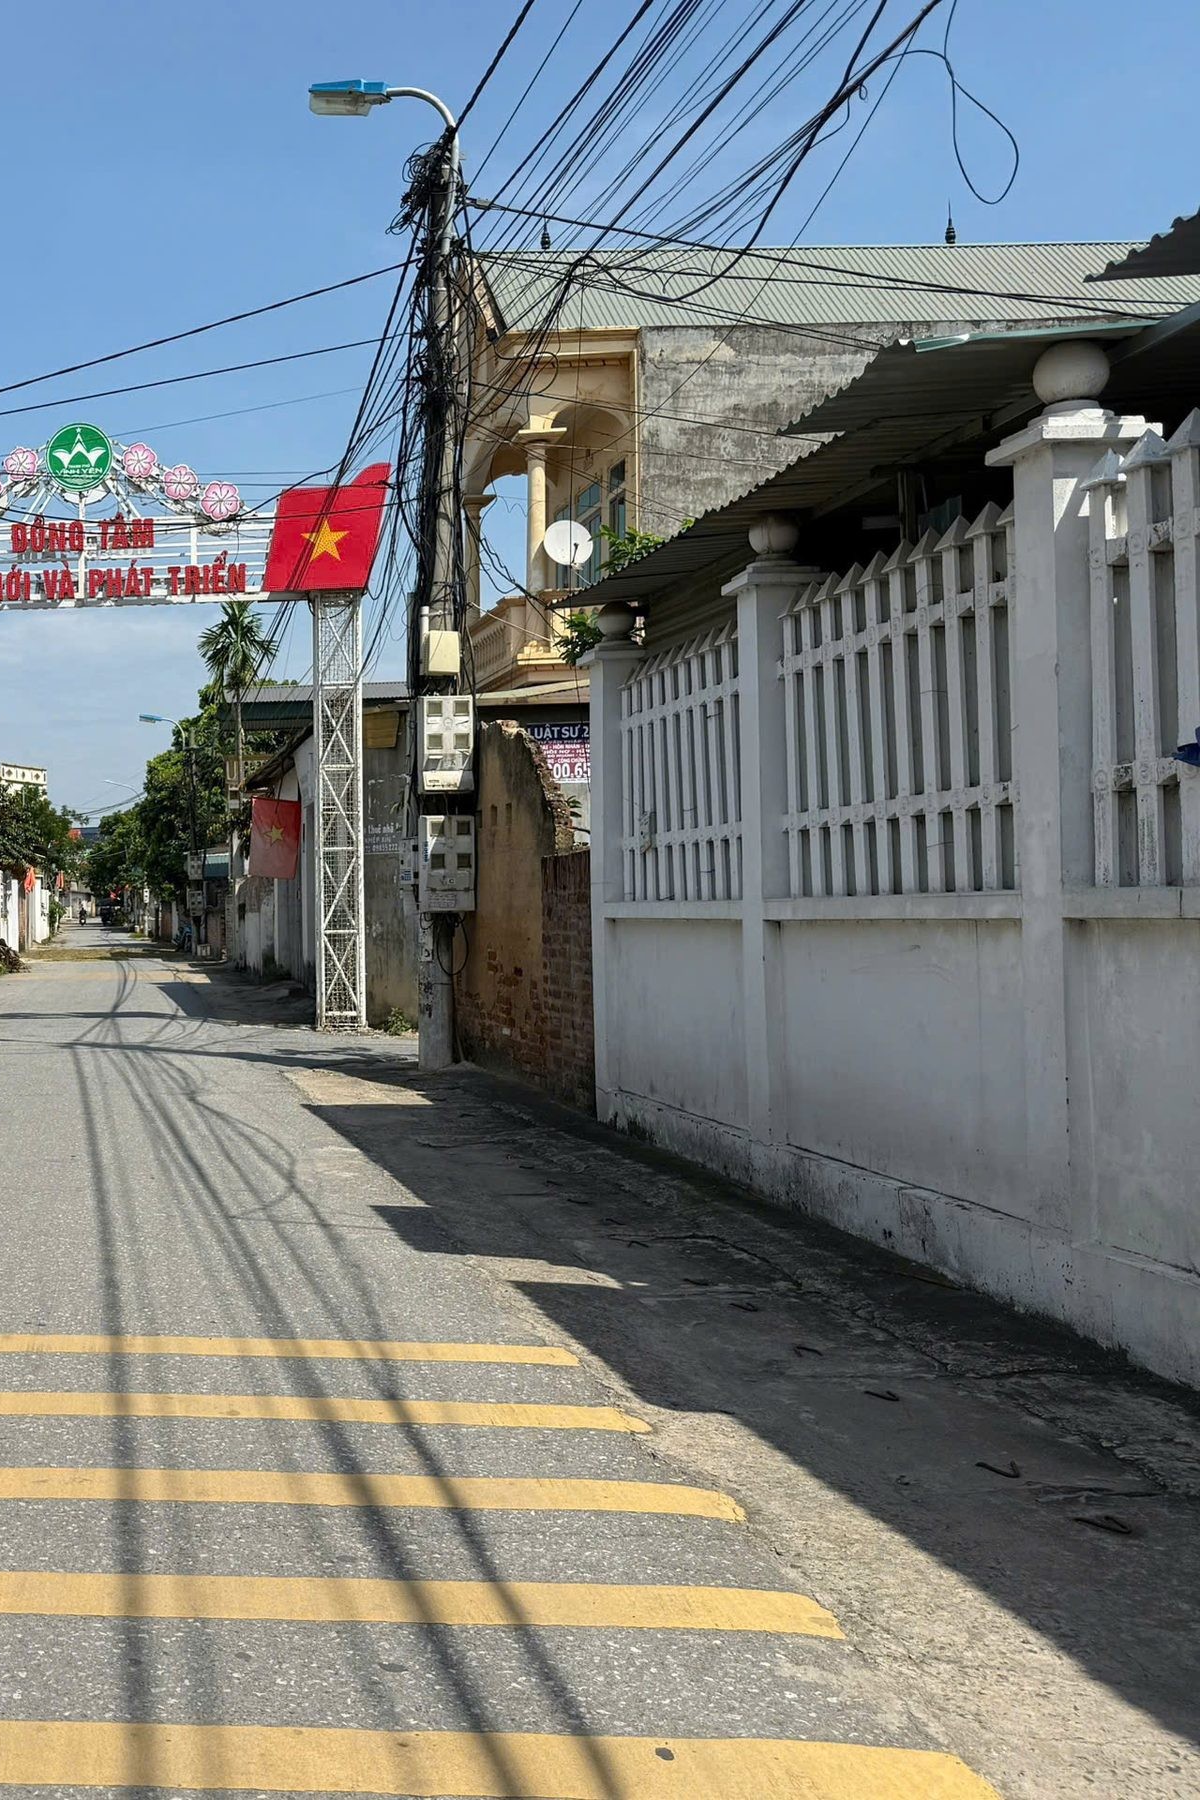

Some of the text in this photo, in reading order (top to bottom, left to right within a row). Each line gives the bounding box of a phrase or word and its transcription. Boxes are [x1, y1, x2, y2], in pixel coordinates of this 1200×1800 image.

[98, 512, 155, 550] TÂM
[43, 560, 75, 599] VÀ
[88, 559, 154, 598] PHÁT
[167, 550, 247, 595] TRIỂN
